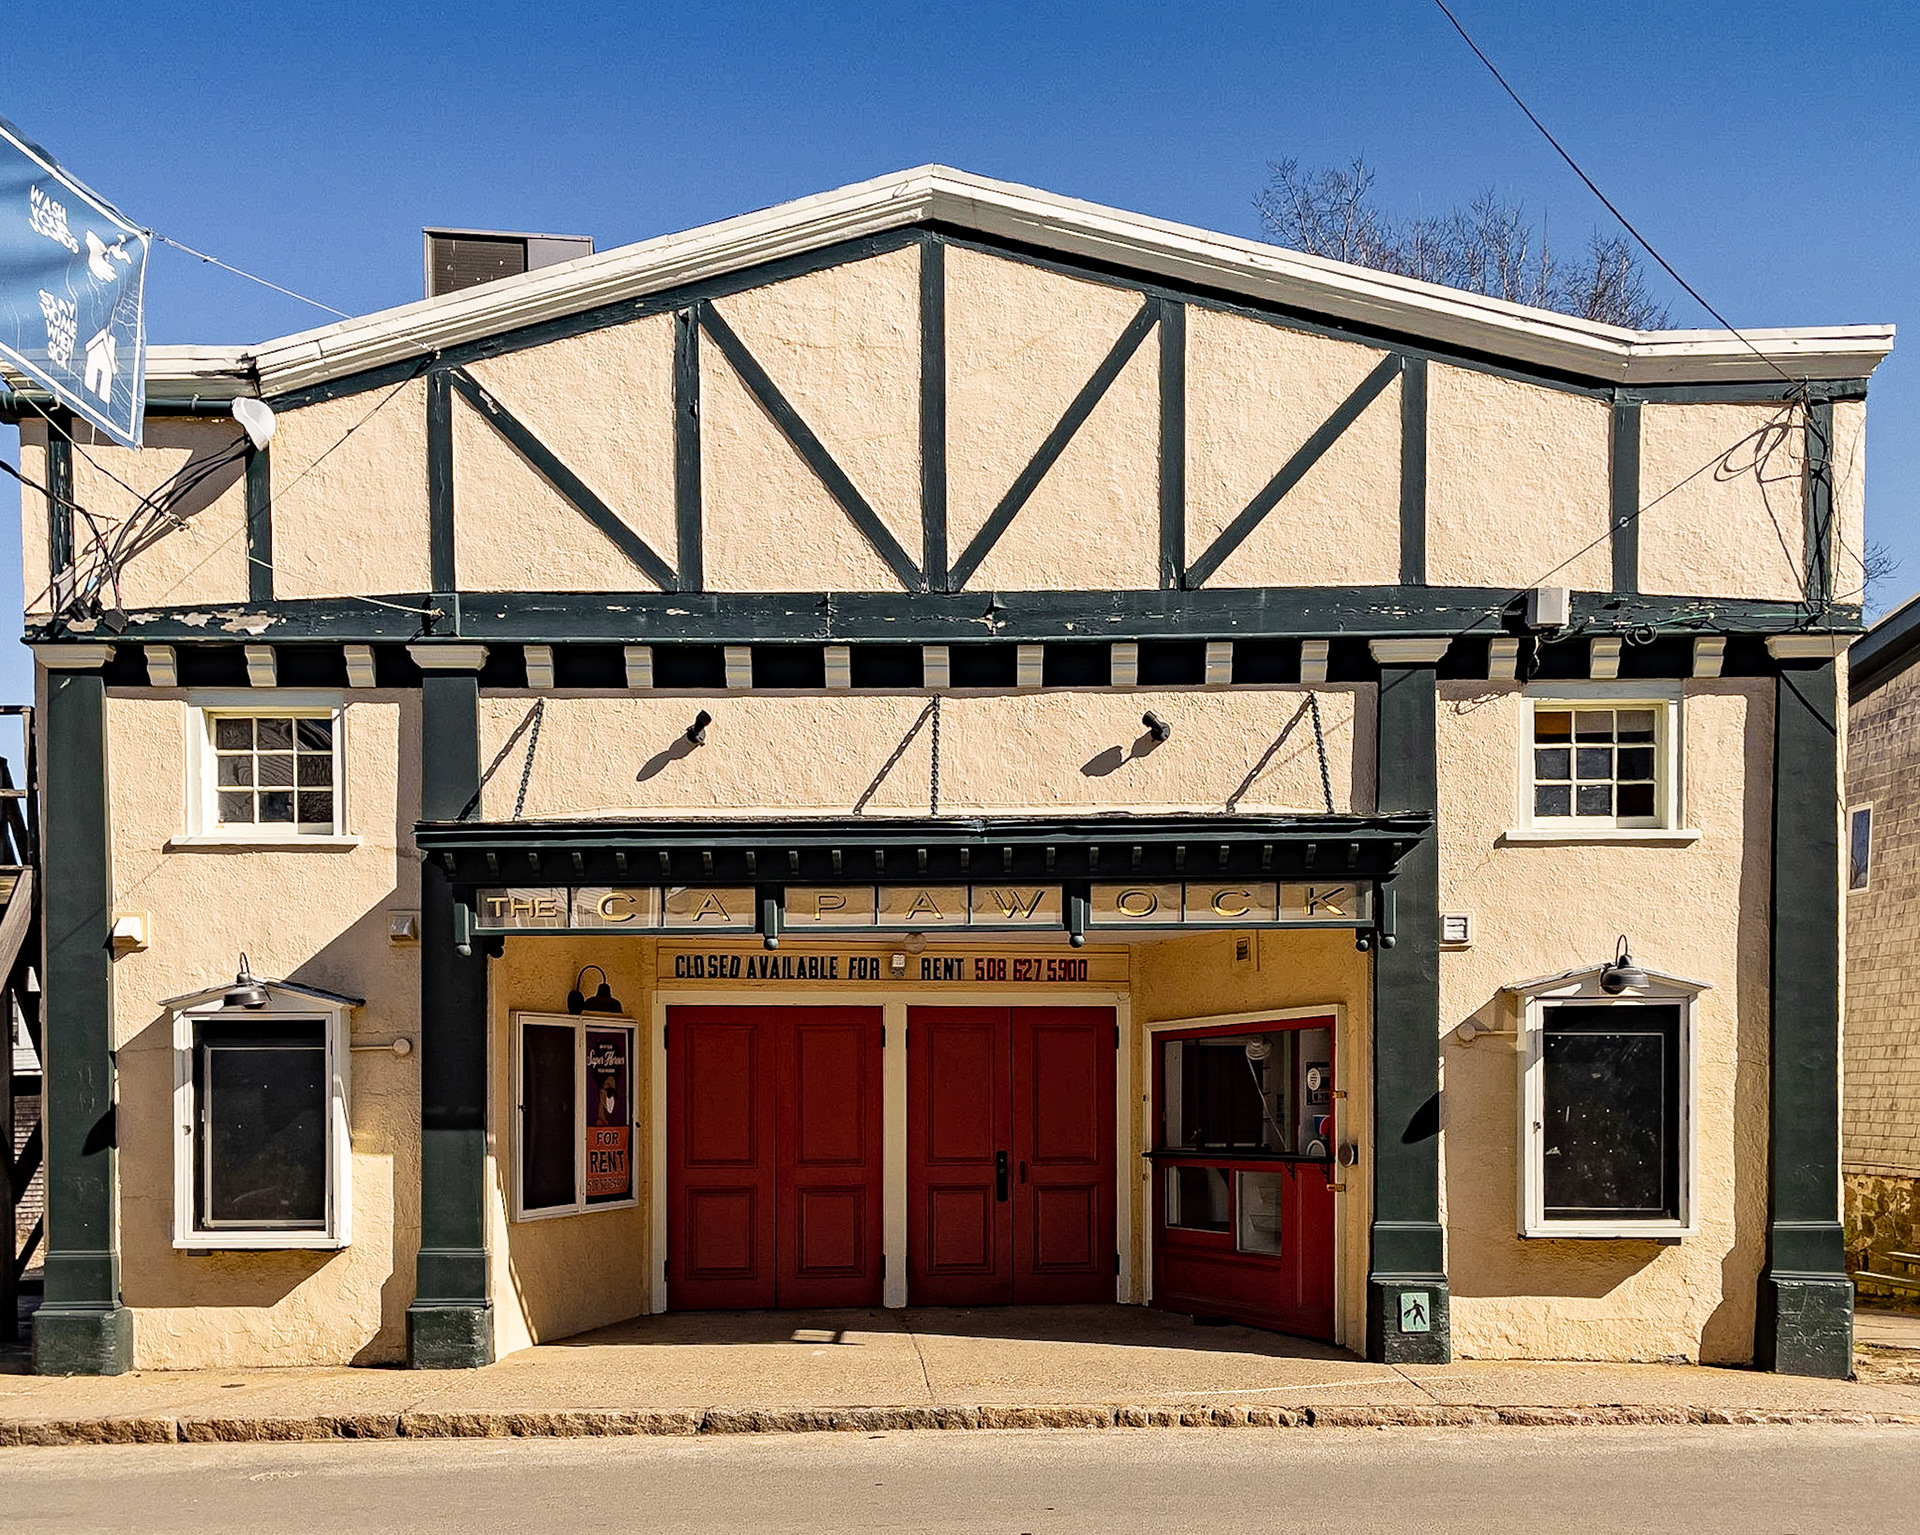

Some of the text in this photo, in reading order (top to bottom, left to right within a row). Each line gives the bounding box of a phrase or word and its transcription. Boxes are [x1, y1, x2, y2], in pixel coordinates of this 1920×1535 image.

[30, 184, 68, 225] WASH
[28, 217, 80, 255] HANDS
[39, 289, 75, 318] STAY
[39, 302, 78, 340] HOME
[46, 319, 75, 356] WHEN
[47, 340, 70, 371] SICK
[486, 886, 1347, 923] THE CAPAWOCK
[675, 954, 1088, 982] CLOSED AVAILABLE FOR RENT 508 627 5900
[596, 1131, 619, 1146] FOR
[589, 1150, 624, 1173] RENT
